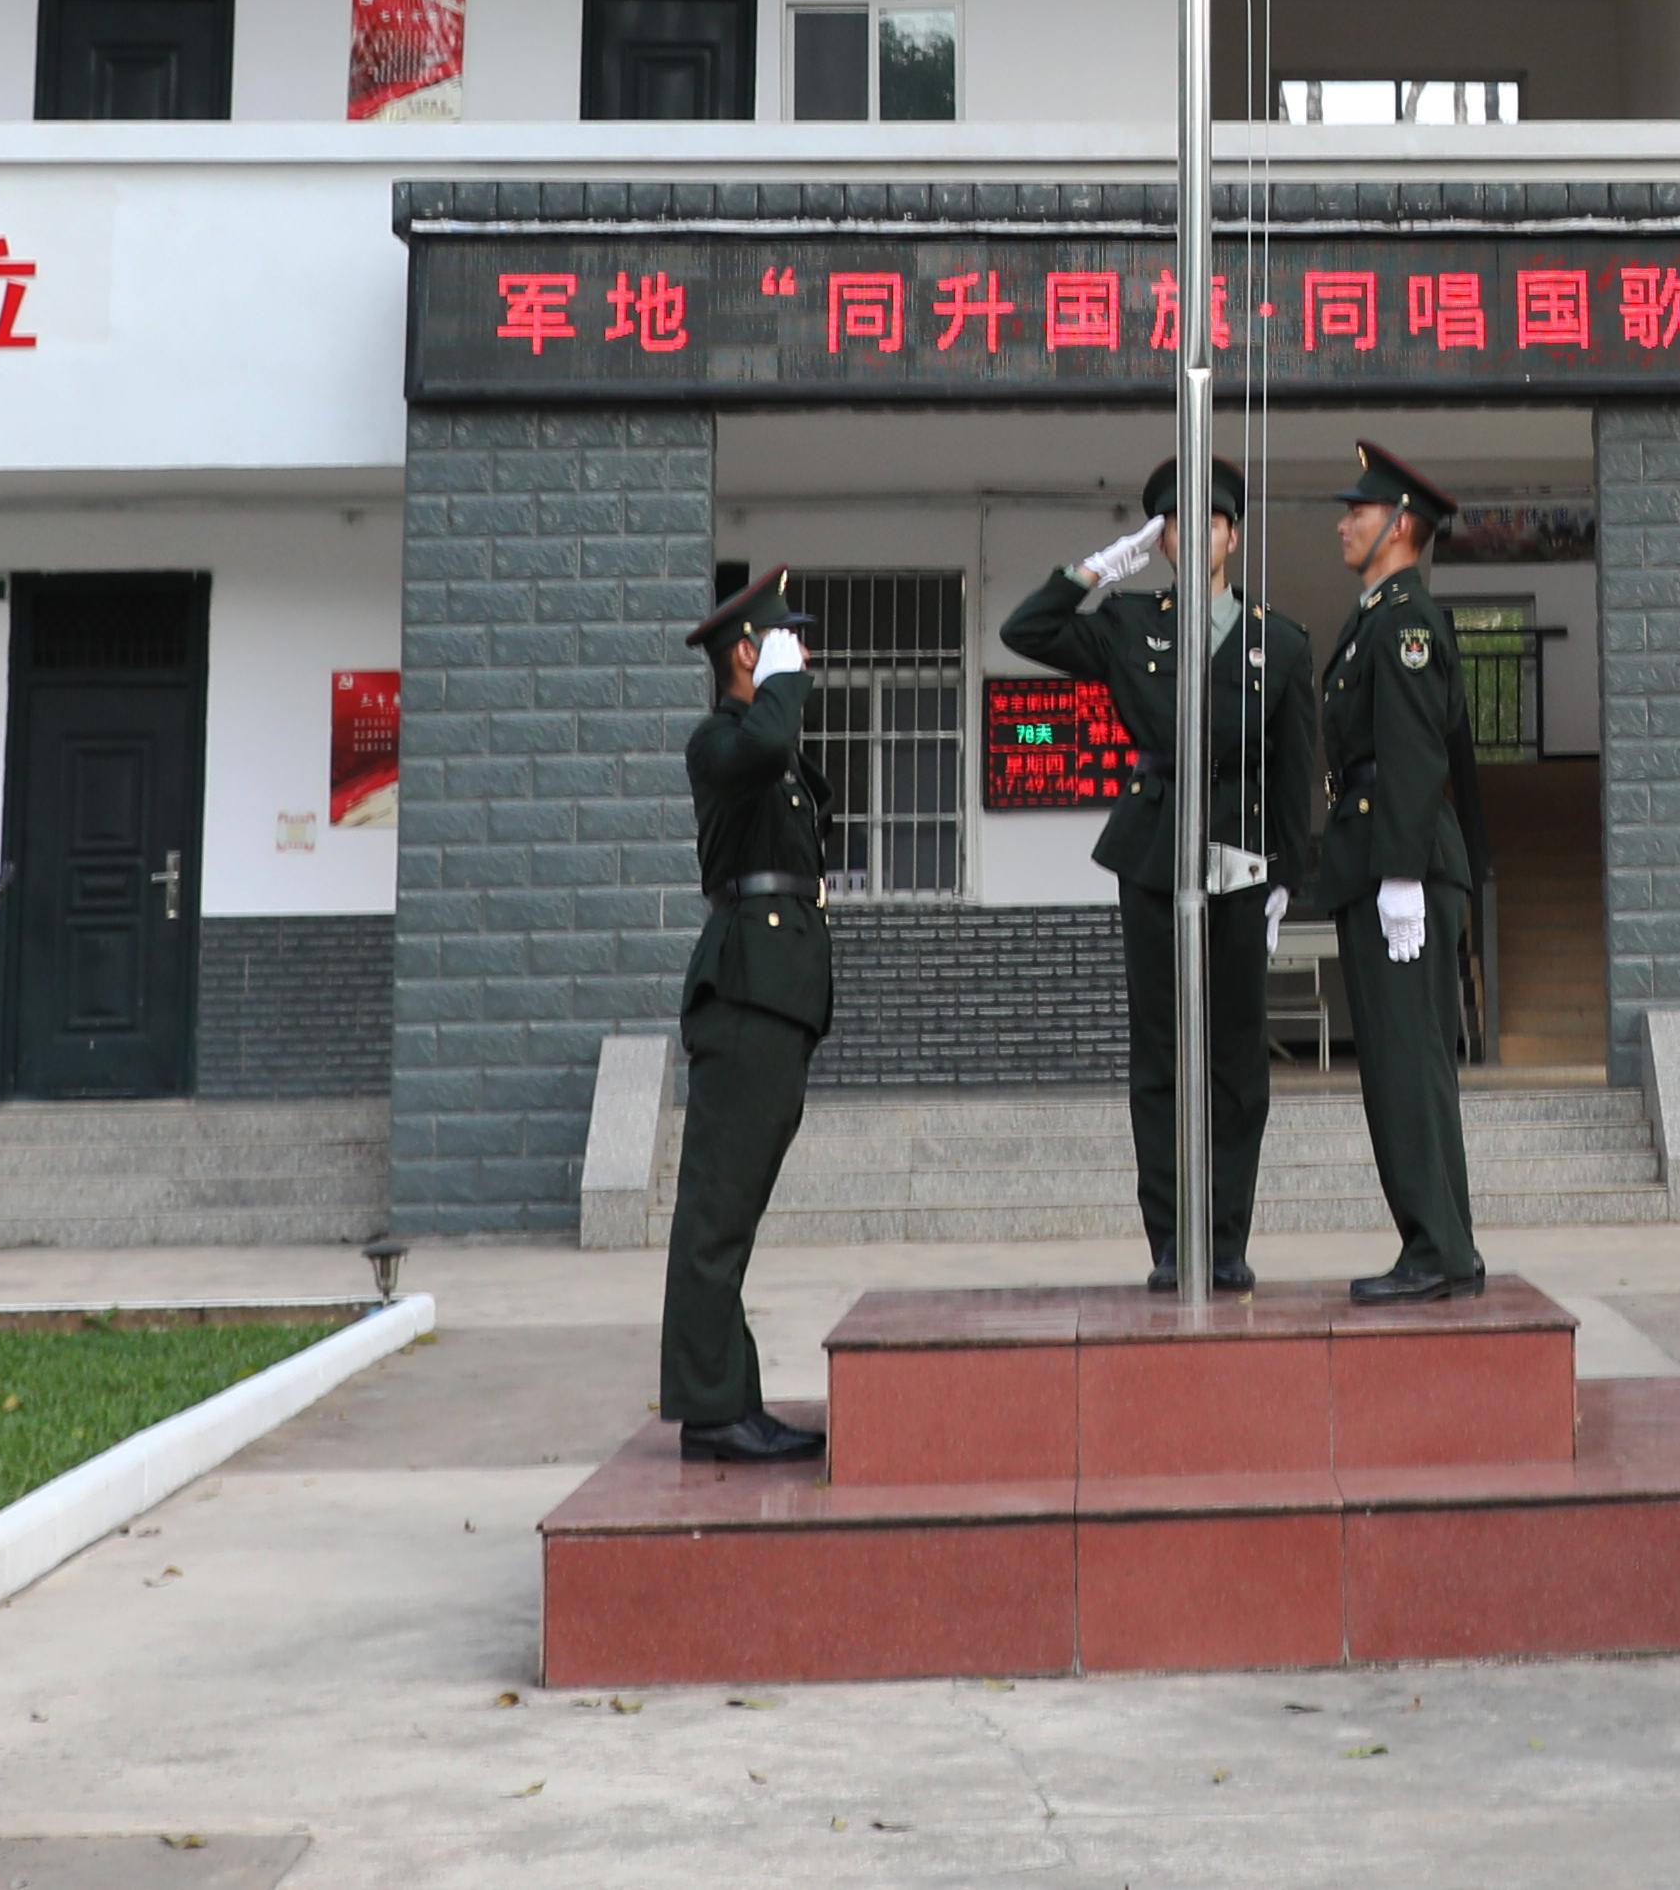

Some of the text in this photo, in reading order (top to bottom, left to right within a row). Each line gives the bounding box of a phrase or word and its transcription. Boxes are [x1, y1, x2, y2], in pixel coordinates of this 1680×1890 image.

[991, 693, 1074, 712] 安全倒计时
[1005, 753, 1065, 775] 星期四
